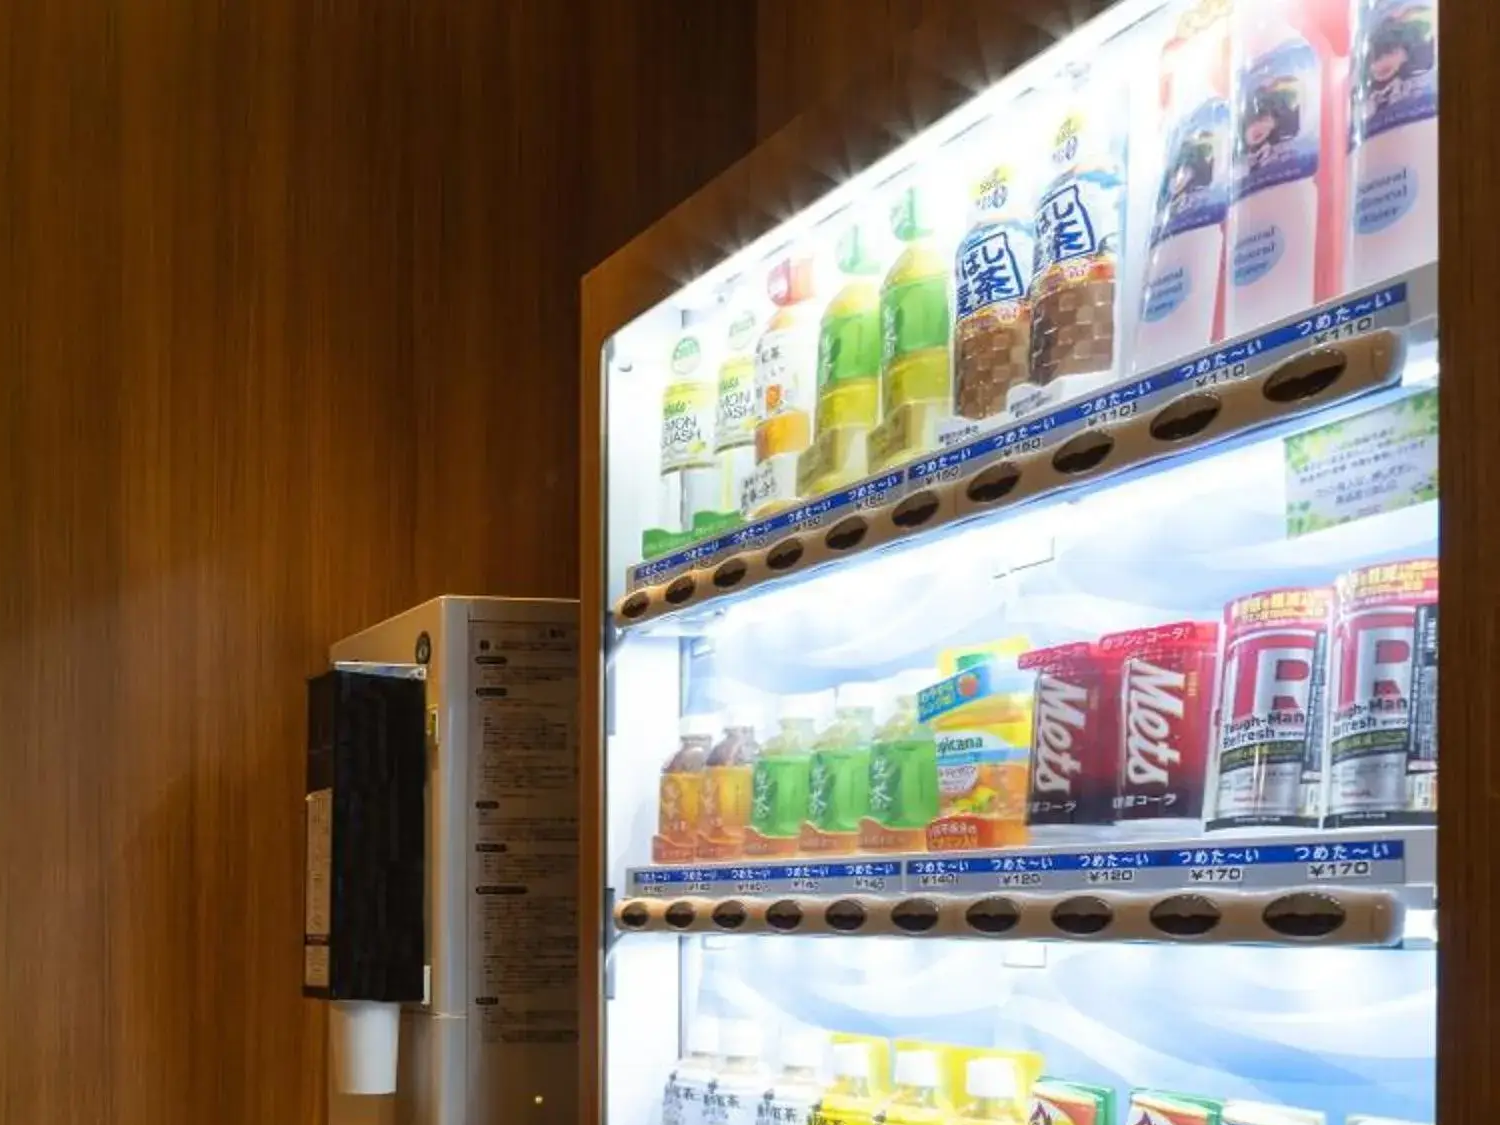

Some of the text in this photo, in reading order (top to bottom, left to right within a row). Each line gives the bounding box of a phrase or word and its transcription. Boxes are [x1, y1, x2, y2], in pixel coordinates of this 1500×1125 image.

[1035, 677, 1089, 795] Mets
[1126, 659, 1188, 788] Mets
[1192, 869, 1241, 880] ¥170
[1310, 862, 1370, 877] ¥170
